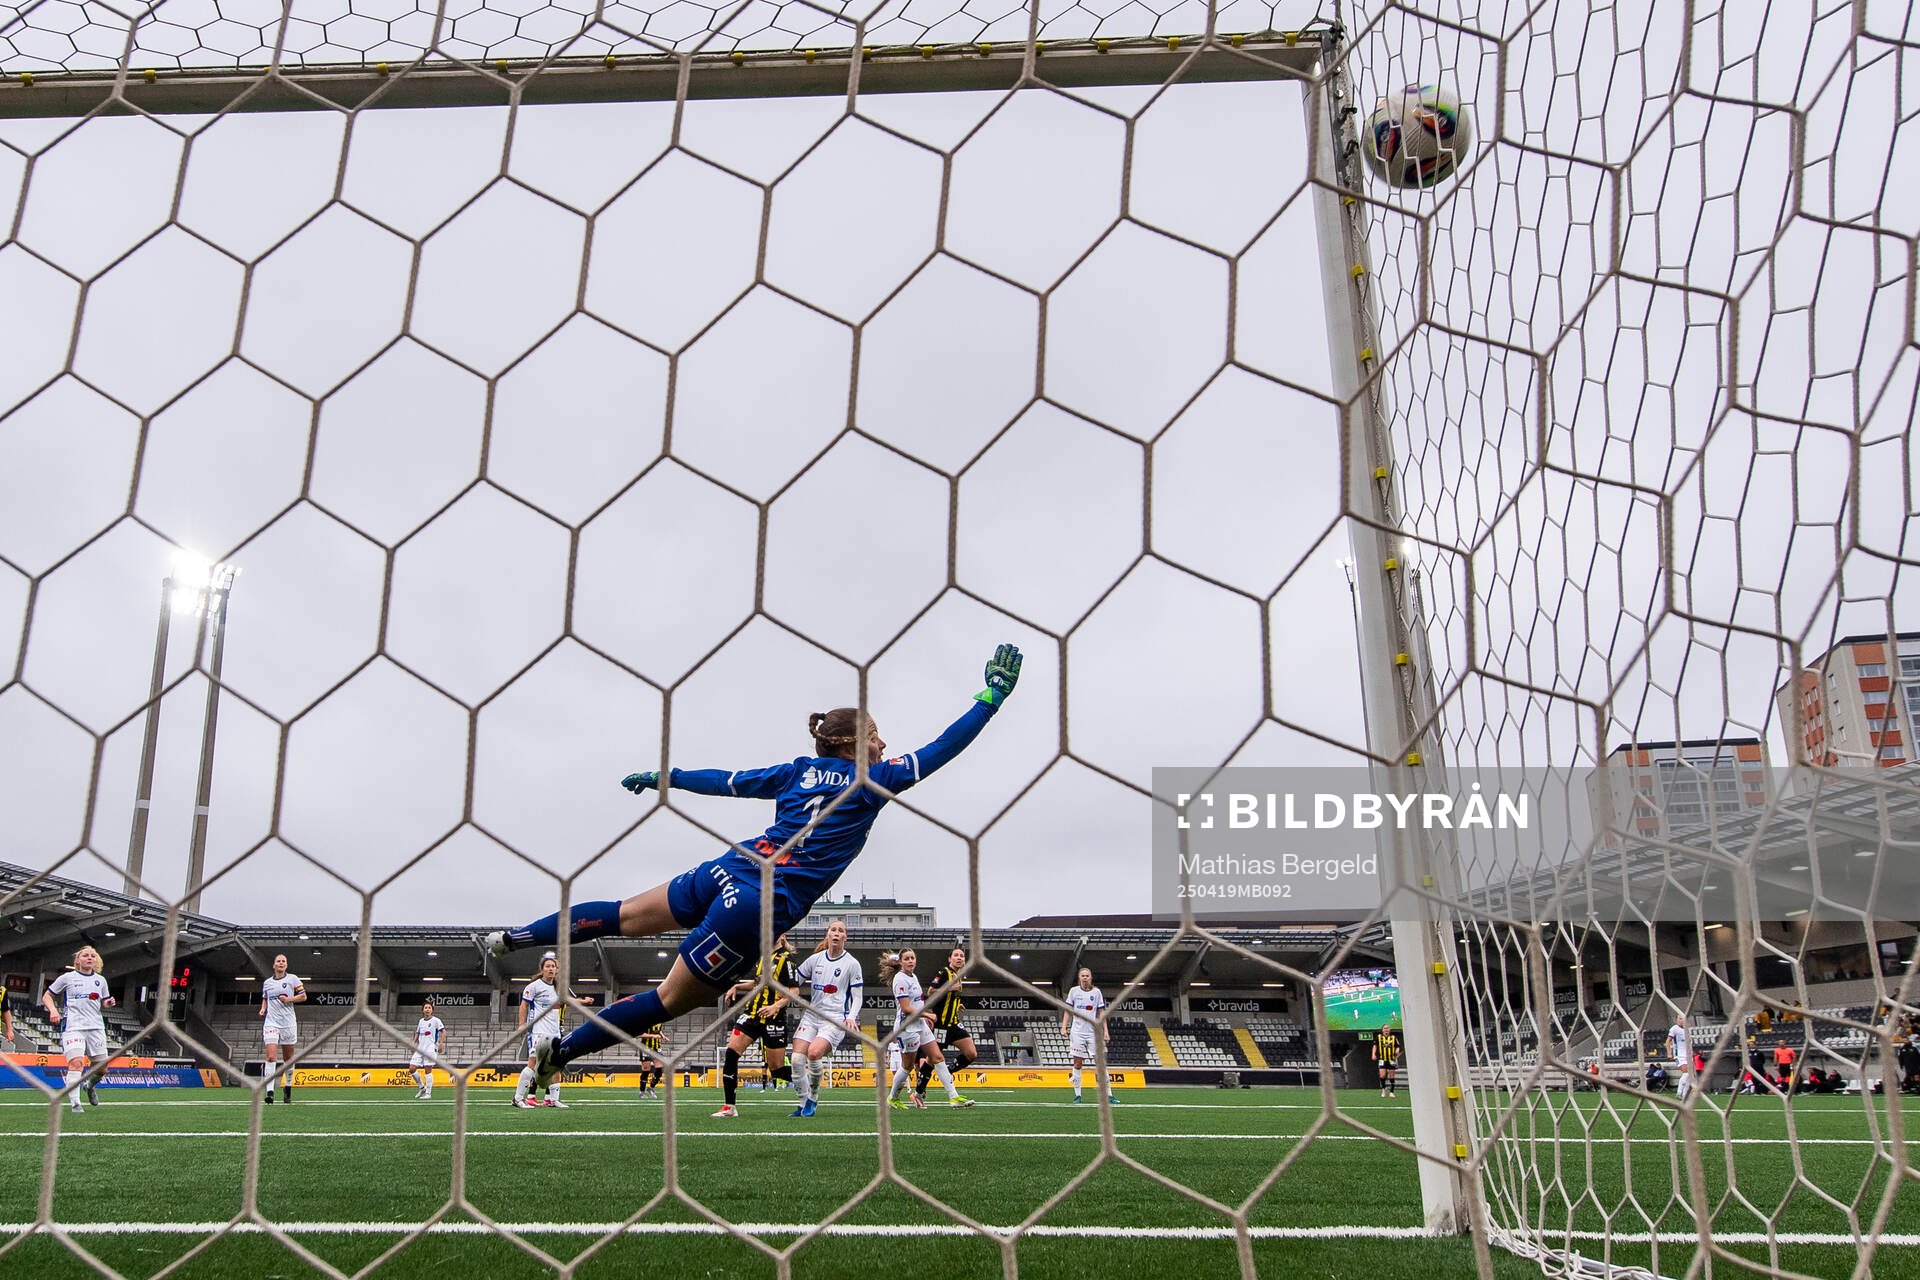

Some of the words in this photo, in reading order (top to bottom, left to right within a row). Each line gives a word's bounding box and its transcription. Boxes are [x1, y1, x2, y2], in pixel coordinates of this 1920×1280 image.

[817, 769, 850, 786] VIDA
[327, 994, 356, 1005] bravi
[435, 994, 474, 1005] bravida
[990, 998, 1030, 1010] bravida
[1218, 1000, 1260, 1012] bravida
[307, 1074, 334, 1082] Gothia
[334, 1074, 351, 1083] Cup
[474, 1073, 511, 1082] SKF
[823, 1071, 861, 1081] SCAPE
